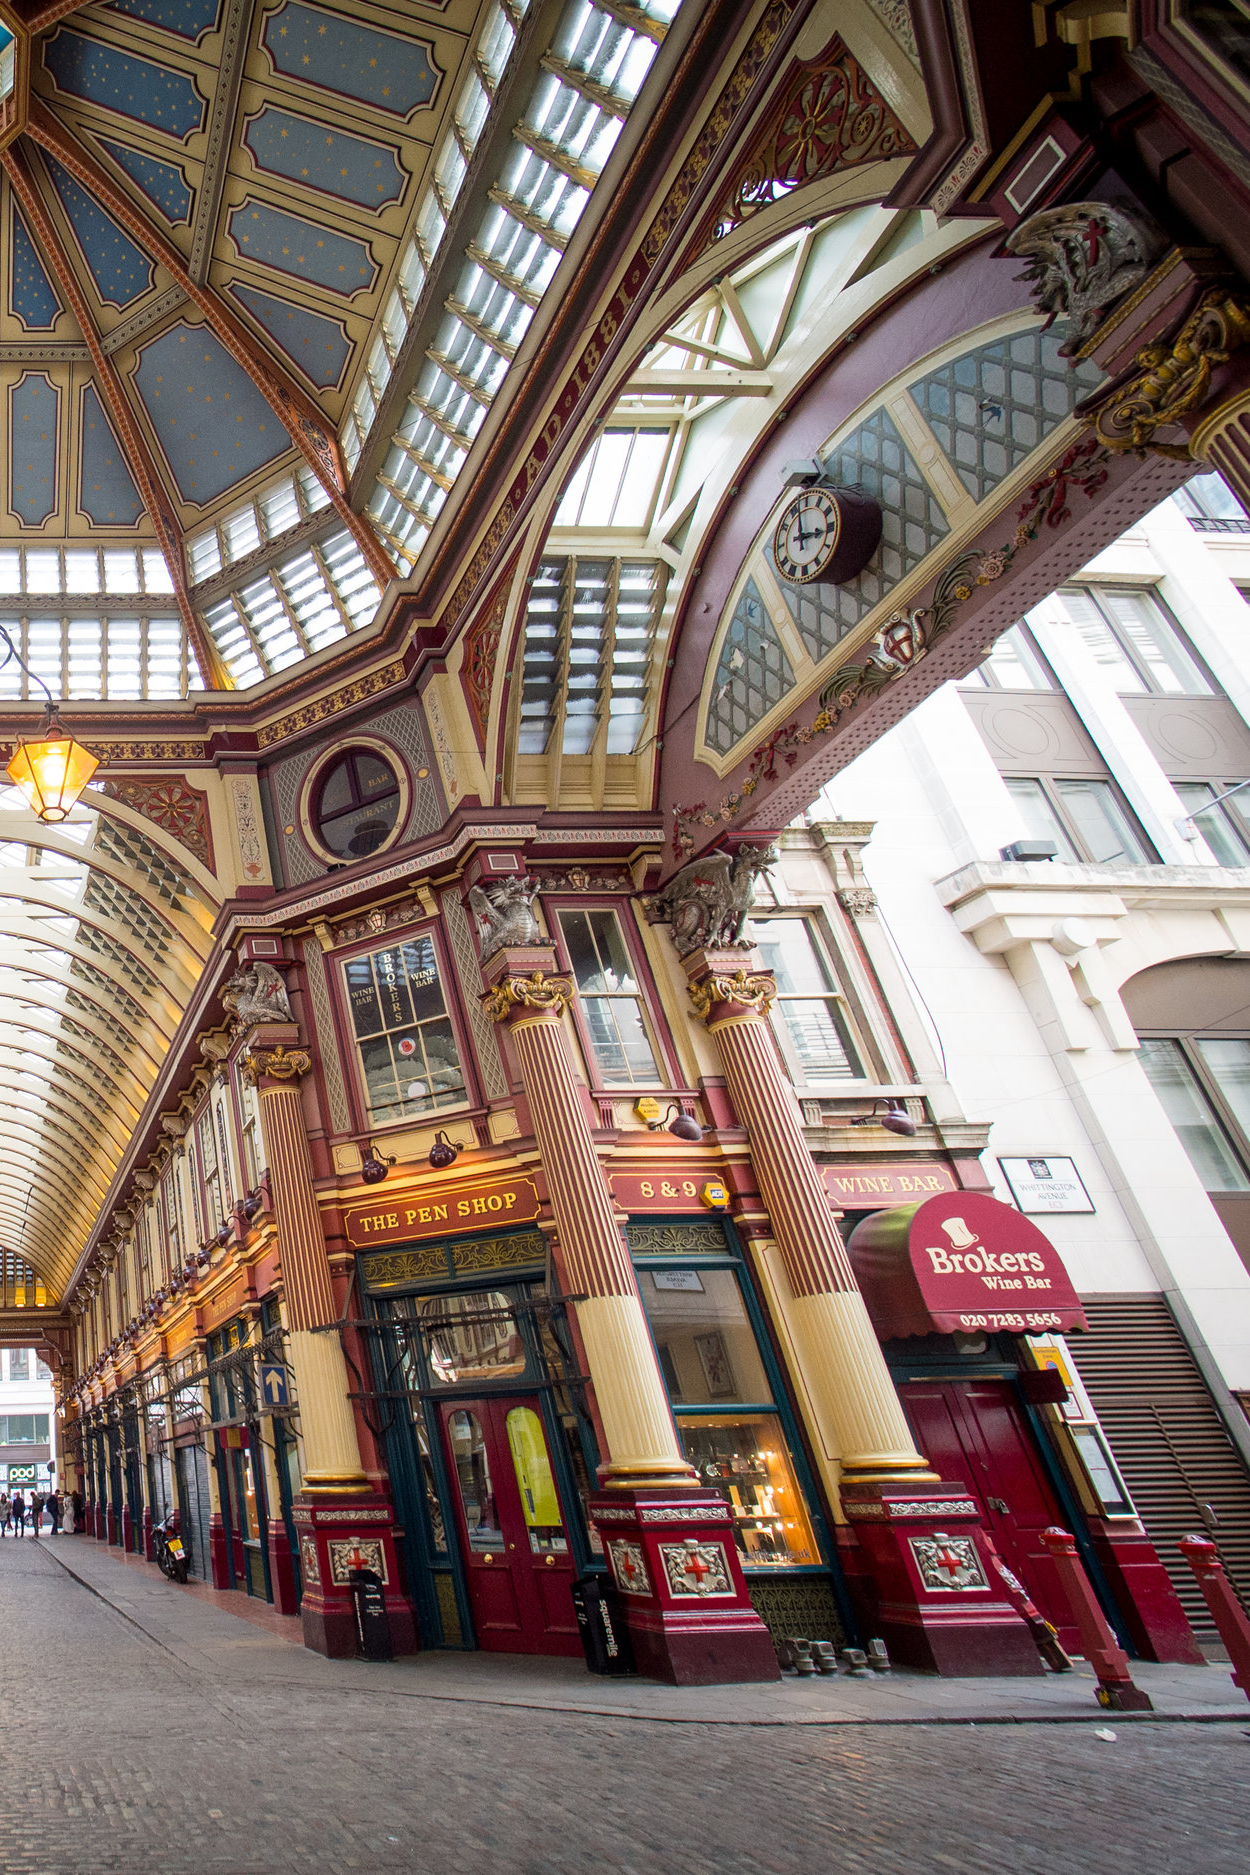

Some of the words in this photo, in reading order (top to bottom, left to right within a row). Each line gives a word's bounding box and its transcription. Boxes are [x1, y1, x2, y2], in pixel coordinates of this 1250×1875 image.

[577, 283, 634, 399] 1881
[410, 967, 436, 981] WINE
[415, 977, 434, 988] BAR
[351, 986, 375, 999] WINE
[383, 953, 403, 1022] BROKERS
[355, 996, 373, 1007] BAR
[640, 1181, 655, 1198] 8
[661, 1181, 679, 1198] &
[682, 1181, 697, 1198] 9
[833, 1176, 895, 1193] WINE
[897, 1175, 945, 1192] BAR
[360, 1213, 400, 1233] THE
[405, 1204, 449, 1226] PEN
[457, 1192, 518, 1217] SHOP
[925, 1246, 1045, 1274] Brokers
[981, 1276, 1023, 1290] Wine
[1023, 1275, 1052, 1289] Bar
[959, 1314, 988, 1327] 020
[988, 1313, 1025, 1328] 7283
[1026, 1312, 1062, 1326] 5656
[10, 1464, 35, 1481] pod
[598, 1599, 619, 1657] squaremile
